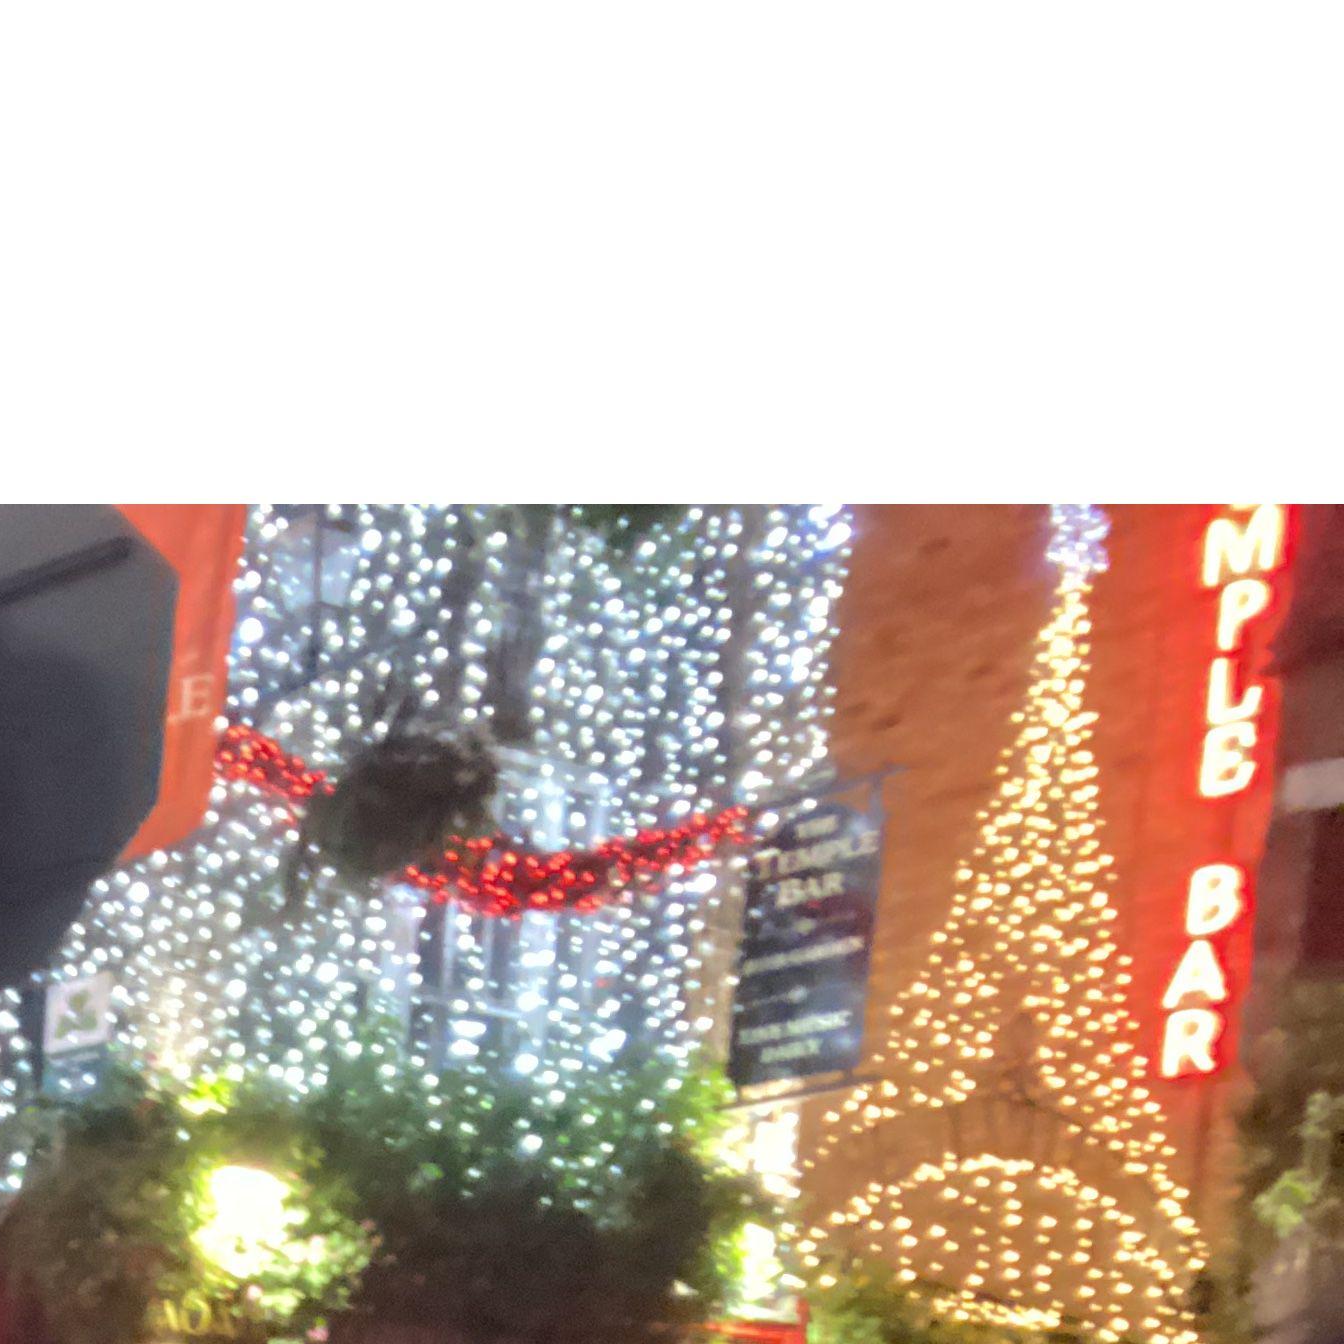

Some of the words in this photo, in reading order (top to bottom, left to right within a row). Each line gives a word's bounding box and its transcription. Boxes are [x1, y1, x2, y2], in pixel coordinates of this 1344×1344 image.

[1200, 504, 1284, 798] MPLE
[753, 830, 880, 881] TEMPLE
[775, 871, 846, 911] BAR
[1161, 863, 1246, 1078] BAR
